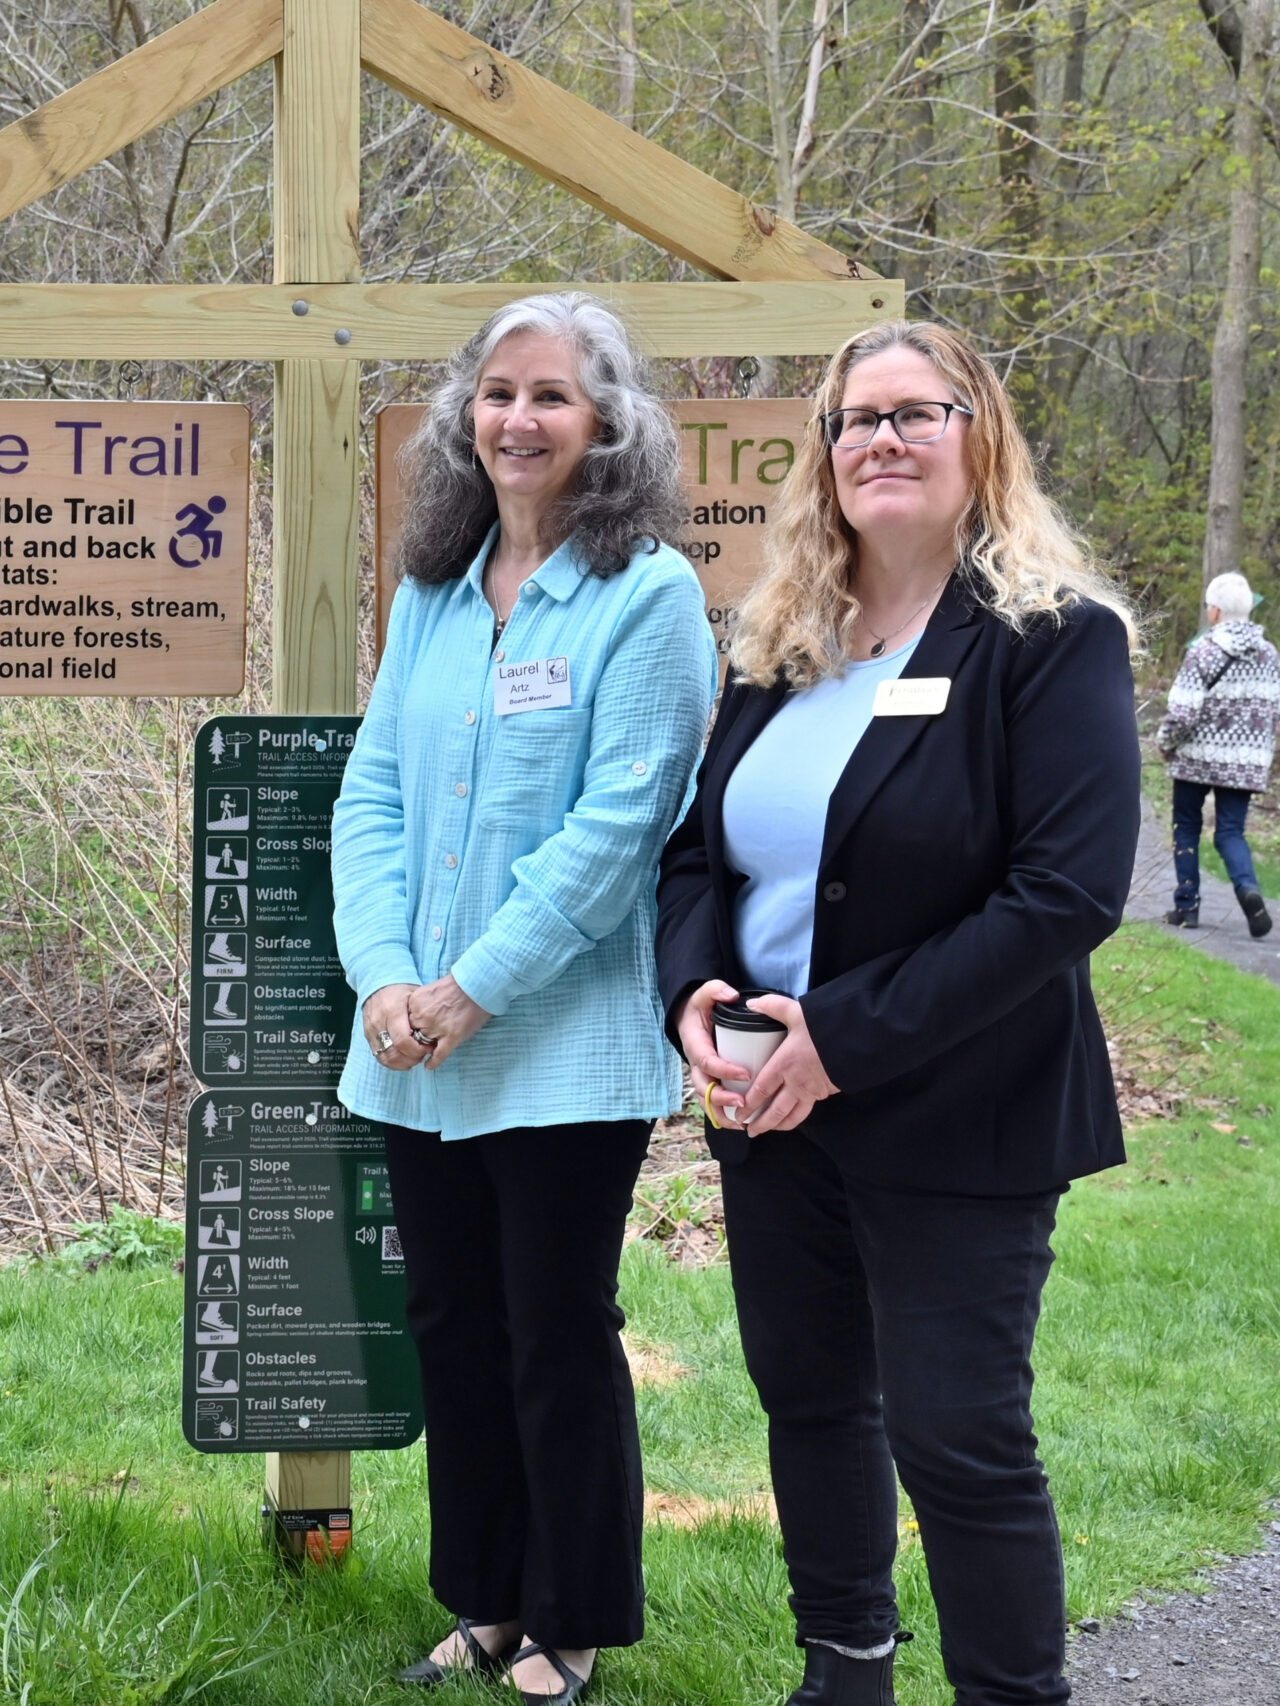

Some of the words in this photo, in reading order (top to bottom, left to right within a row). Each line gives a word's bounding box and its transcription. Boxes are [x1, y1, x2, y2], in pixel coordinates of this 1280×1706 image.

[55, 420, 200, 476] Trail
[680, 423, 795, 485] Tra
[64, 498, 135, 525] Trail
[23, 534, 77, 559] and
[86, 535, 156, 559] back
[130, 598, 227, 622] stream,
[73, 626, 172, 652] forests,
[61, 658, 117, 680] field
[499, 662, 539, 679] Laurel
[510, 684, 529, 693] Artz
[528, 694, 552, 702] Member
[259, 728, 319, 751] Purple
[324, 729, 355, 747] Tra
[257, 752, 281, 761] TRAIL
[284, 752, 318, 761] ACCESS
[257, 787, 299, 803] Slope
[257, 806, 281, 814] Typical:
[256, 837, 298, 850] Cross
[302, 837, 332, 853] Slop
[256, 887, 298, 901] Width
[220, 894, 233, 909] 5'
[256, 905, 279, 913] Typical:
[255, 936, 312, 949] Surface
[255, 955, 291, 963] Compacted
[254, 985, 326, 999] Obstacles
[265, 1004, 298, 1012] significant
[299, 1004, 332, 1012] protruding
[253, 1030, 286, 1044] Trail
[290, 1030, 336, 1046] Safety
[251, 1102, 304, 1120] Green
[250, 1125, 273, 1133] TRAIL
[276, 1125, 309, 1133] ACCESS
[311, 1124, 371, 1133] INFORMATION
[249, 1158, 290, 1174] Slope
[363, 1167, 381, 1175] Trail
[249, 1177, 273, 1185] Typical:
[248, 1207, 290, 1220] Cross
[294, 1206, 335, 1223] Slope
[248, 1256, 289, 1269] Width
[212, 1263, 226, 1279] 4'
[246, 1303, 303, 1317] Surface
[367, 1321, 391, 1329] bridges
[246, 1351, 317, 1365] Obstacles
[347, 1378, 367, 1386] bridge
[245, 1397, 277, 1410] Trail
[281, 1396, 327, 1412] Safety
